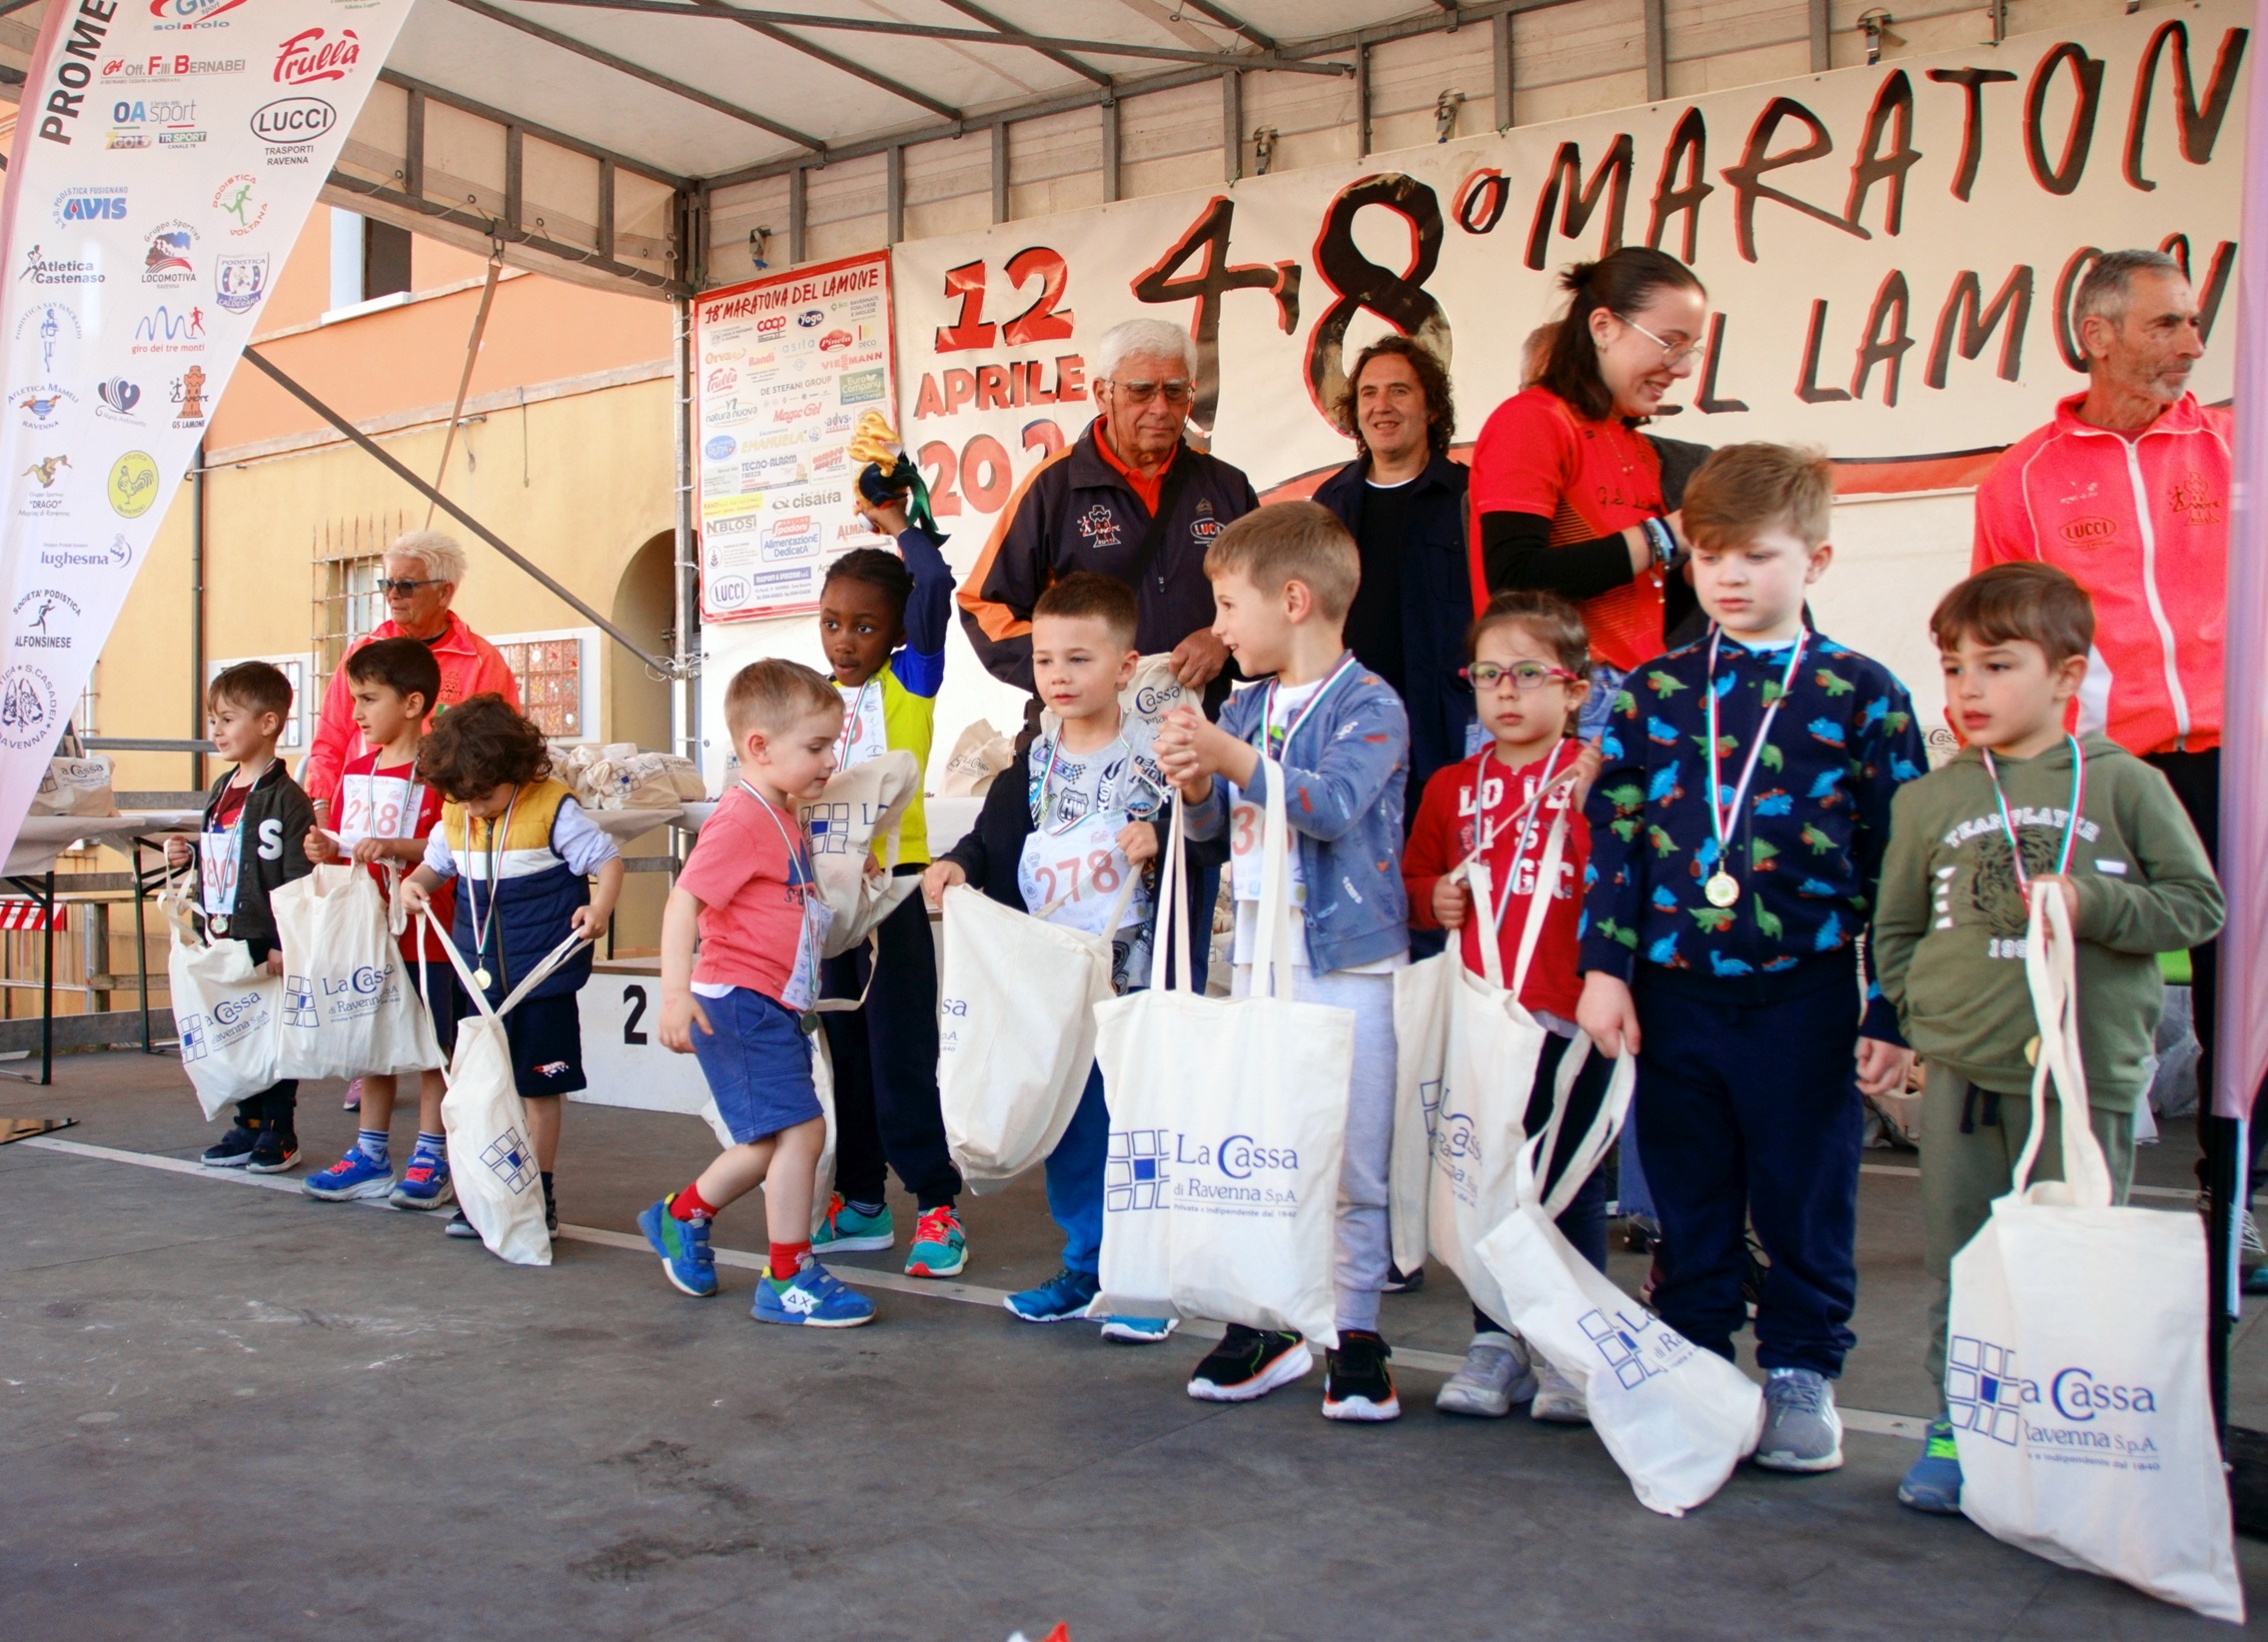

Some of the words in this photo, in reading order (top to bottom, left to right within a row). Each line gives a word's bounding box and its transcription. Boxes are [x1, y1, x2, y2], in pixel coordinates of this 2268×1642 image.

[153, 20, 230, 31] solarolo
[125, 64, 146, 76] Off.
[174, 54, 246, 74] BERNABEI
[273, 28, 360, 83] Frullà
[113, 101, 146, 124] OA
[149, 99, 197, 125] sport
[258, 108, 328, 133] LUCCI
[173, 132, 206, 142] SPORT
[1523, 19, 2249, 272] MARATON
[265, 145, 314, 156] TRASPORTI
[267, 155, 309, 166] RAVENNA
[56, 187, 88, 208] PODISTICA
[89, 186, 128, 195] FUSIGNANO
[212, 174, 257, 208] PODISTICA
[63, 197, 127, 221] AVIS
[230, 203, 269, 236] VOLTANA
[144, 221, 170, 243] Gruppo
[172, 218, 201, 241] Sportivo
[38, 260, 94, 272] Atletica
[35, 273, 106, 284] Castenaso
[141, 273, 197, 283] LOCOMOTIVA
[723, 288, 788, 320] MARATONA
[791, 283, 818, 304] DEL
[822, 269, 878, 297] LAMONE
[850, 295, 879, 306] RAVENNATE
[934, 246, 1074, 354] 12
[15, 304, 42, 340] PODISTICA
[58, 303, 82, 340] PANCRAZIO
[799, 311, 822, 326] Yoga
[855, 308, 876, 317] IMOLESE
[1794, 233, 2237, 408] LAMON
[756, 315, 787, 333] coop
[131, 345, 148, 355] giro
[150, 344, 163, 353] dei
[180, 343, 205, 352] monti
[821, 335, 851, 347] Pineta
[748, 352, 775, 367] Randi
[706, 367, 738, 392] Frullà
[772, 381, 803, 394] STEFANI
[804, 376, 832, 388] GROUP
[842, 382, 881, 394] Company
[846, 376, 866, 386] Euro
[913, 354, 1088, 421] APRILE
[8, 385, 45, 404] ATLETICA
[48, 383, 80, 404] MAMELI
[705, 409, 731, 422] natura
[731, 406, 758, 418] nuova
[772, 408, 803, 425] Magic
[803, 401, 822, 416] Gel
[22, 420, 60, 431] RAVENNA
[182, 420, 206, 429] LAMONE
[740, 454, 797, 473] TECNO-ALARM
[917, 419, 1067, 518] 202
[792, 490, 841, 509] cisalfa
[719, 518, 757, 533] BLOSI
[2065, 521, 2109, 540] LUCCI
[40, 552, 109, 569] lughesina
[714, 582, 744, 603] LUCCI
[44, 589, 82, 618] PODISTICA
[14, 636, 72, 650] ALFONSINESE
[1136, 684, 1181, 715] Cassa
[70, 764, 104, 779] Cassa
[343, 799, 399, 836] 218
[257, 819, 284, 860] S
[1035, 849, 1120, 908] 278
[322, 976, 350, 996] La
[214, 991, 261, 1025] Cassa
[328, 1005, 337, 1014] di
[623, 983, 647, 1045] 2
[213, 1019, 251, 1044] avenna
[1175, 1133, 1211, 1165] La
[1217, 1134, 1299, 1179] Cassa
[1174, 1182, 1184, 1196] di
[1188, 1178, 1261, 1201] Ravenna
[1173, 1203, 1199, 1212] Privata
[2051, 1366, 2157, 1422] Cassa
[2112, 1460, 2128, 1470] dal
